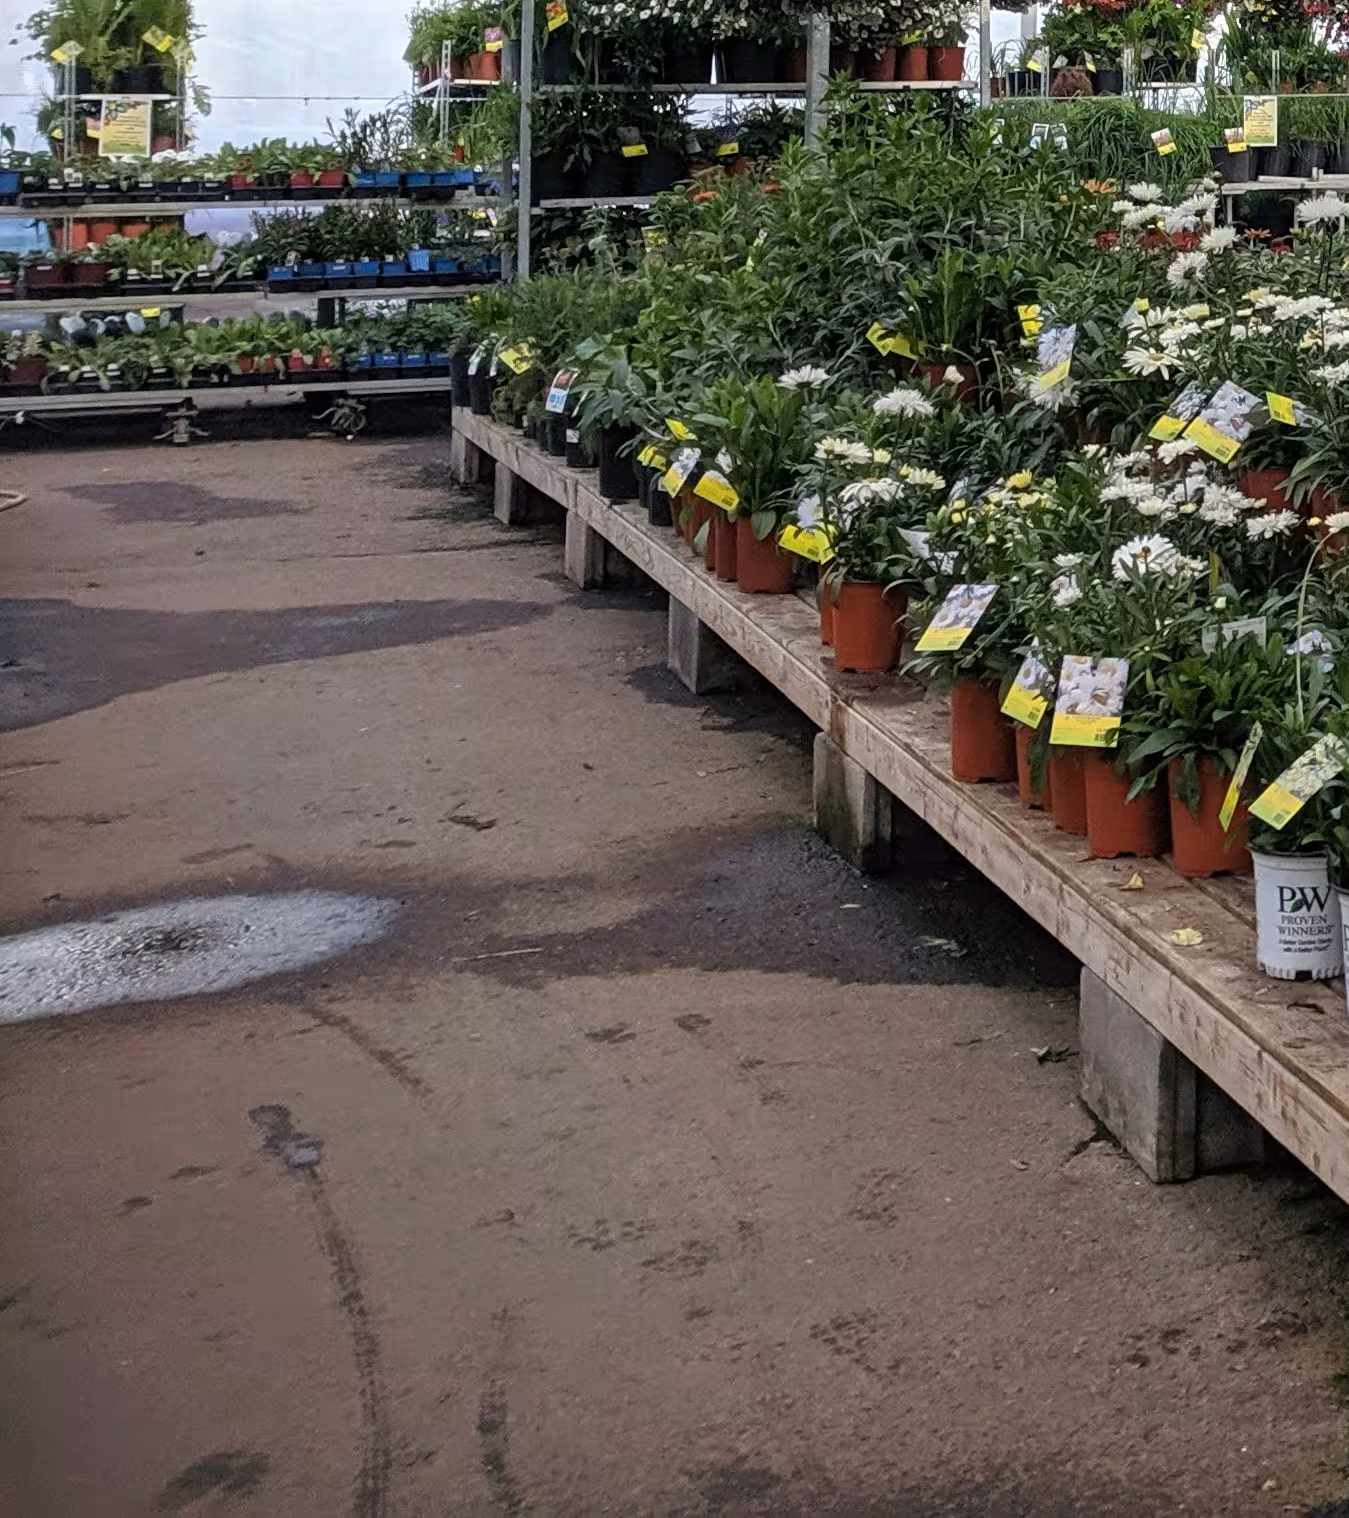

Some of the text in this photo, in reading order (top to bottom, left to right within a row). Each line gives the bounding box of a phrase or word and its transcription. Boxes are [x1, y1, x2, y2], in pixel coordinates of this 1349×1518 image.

[1277, 885, 1332, 913] PW
[1281, 915, 1327, 925] PROVEN
[1277, 925, 1333, 936] WINNERS
